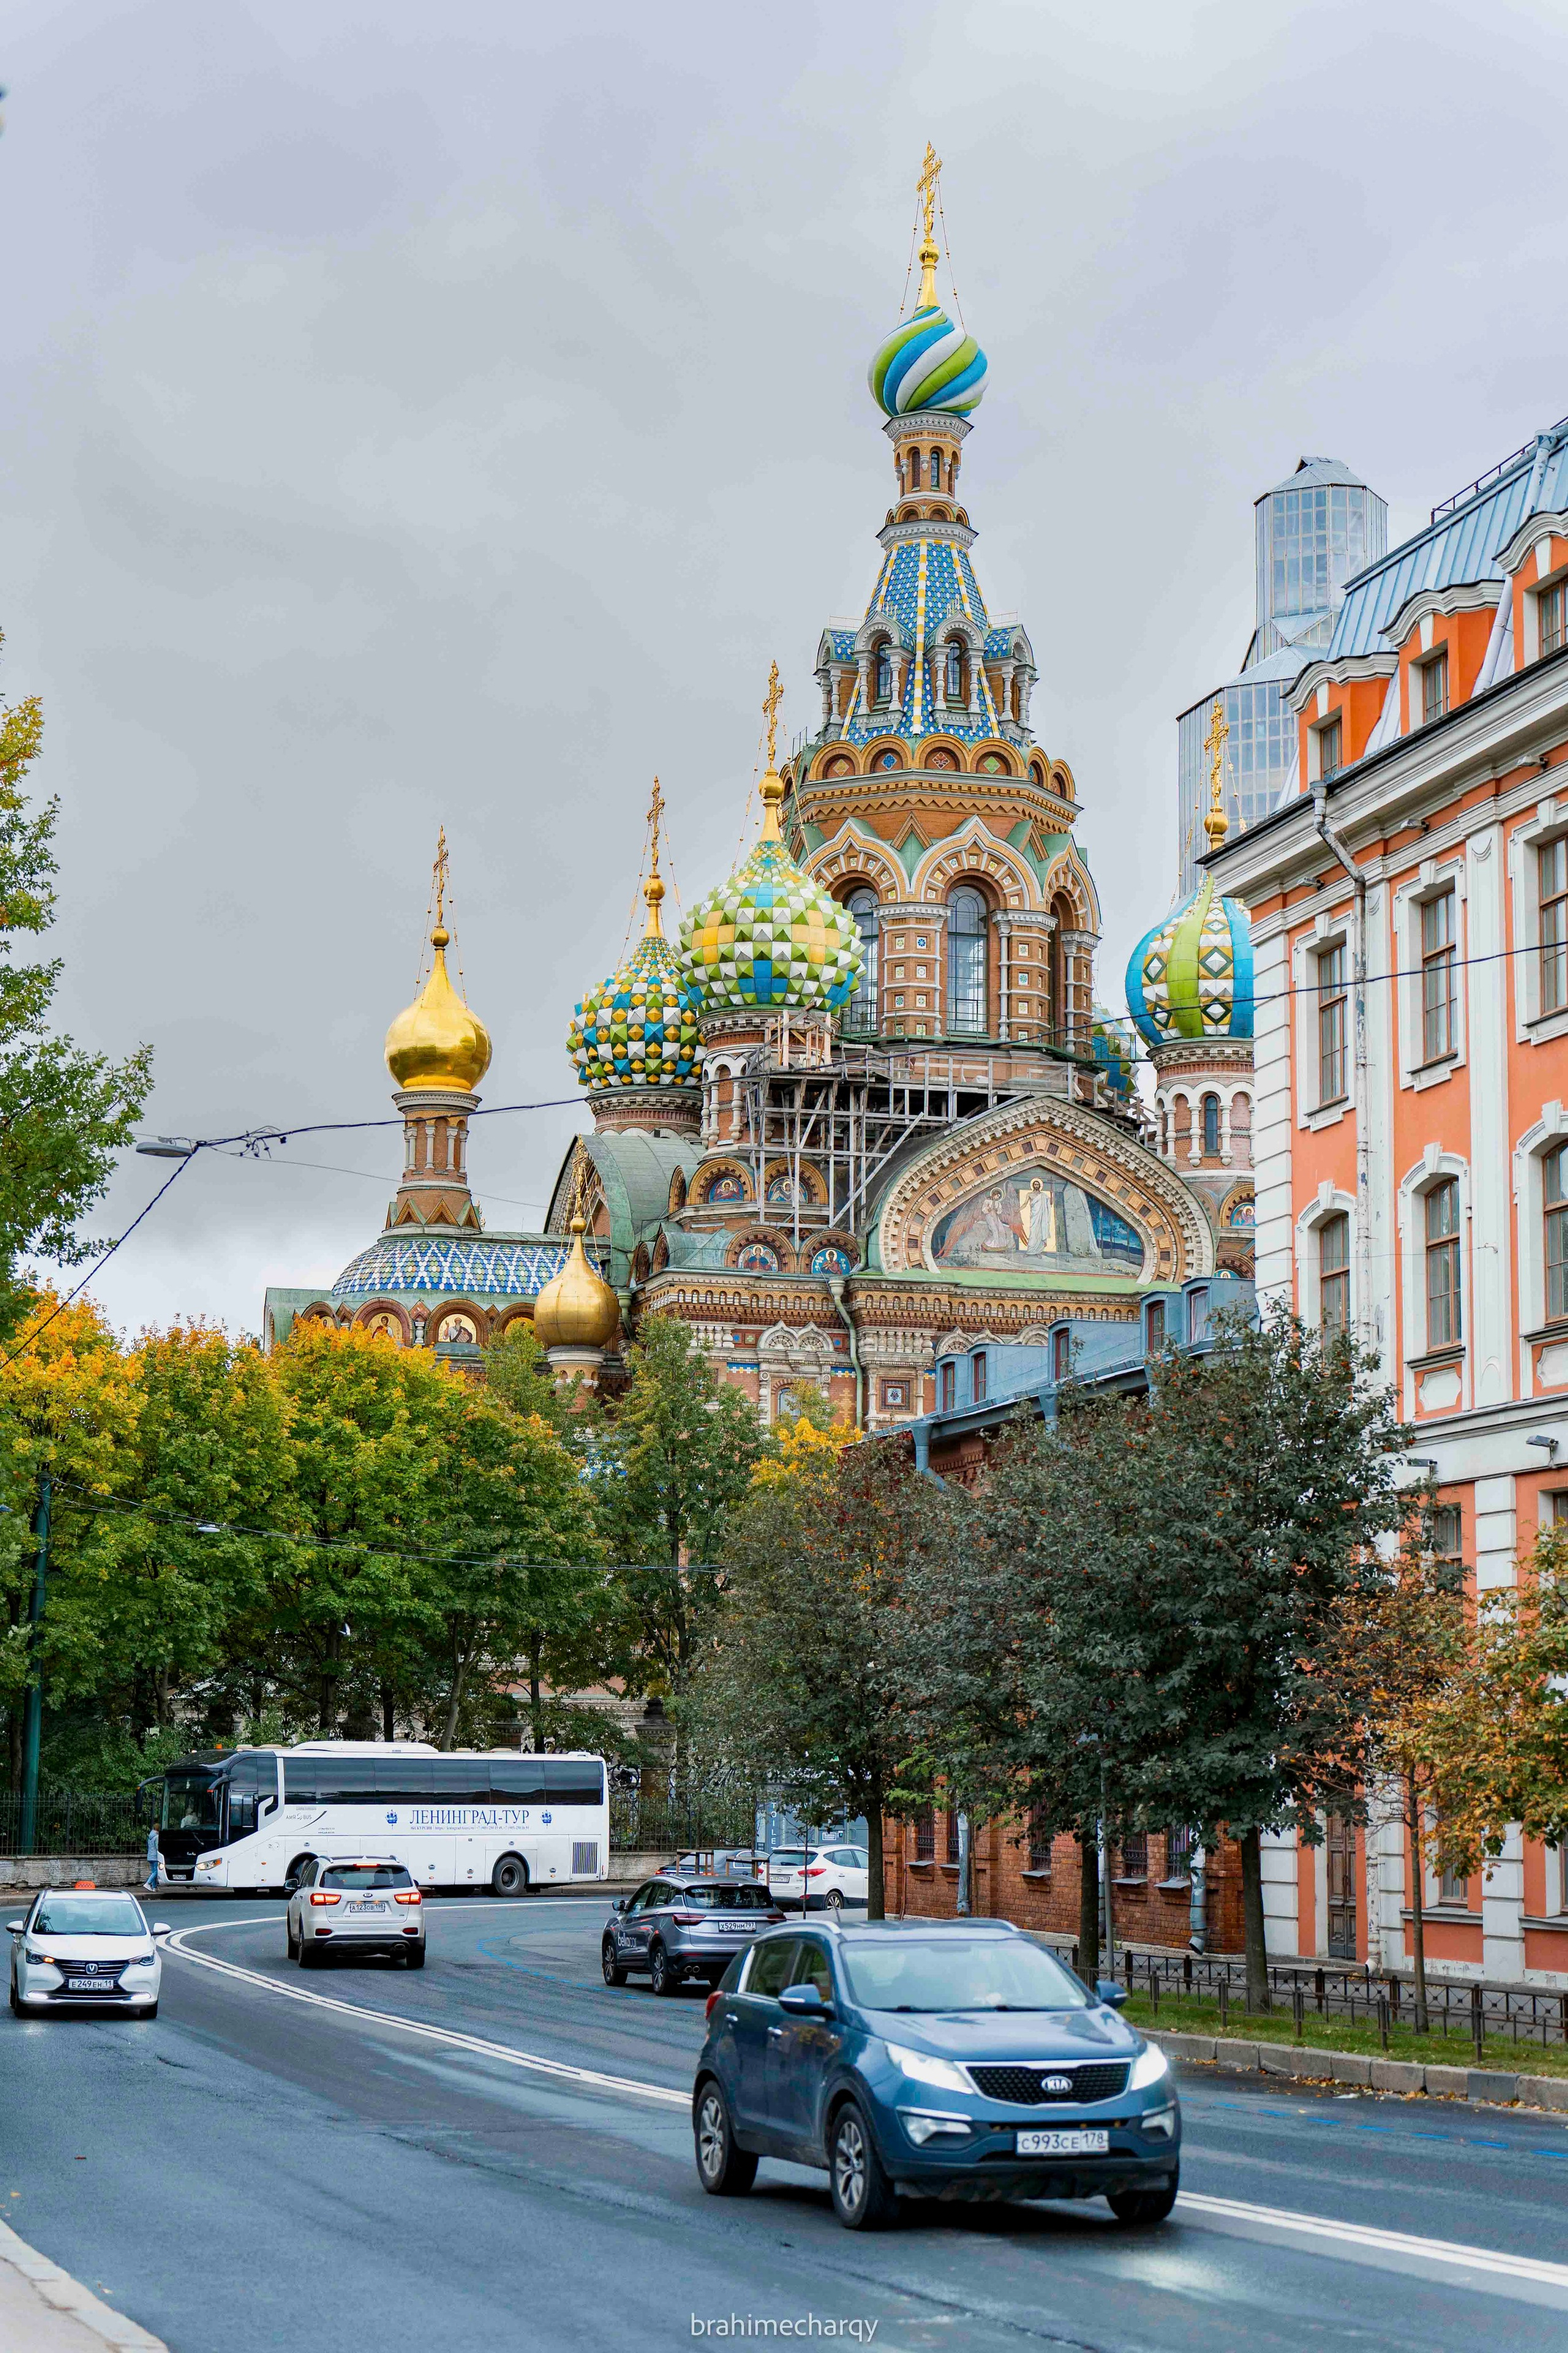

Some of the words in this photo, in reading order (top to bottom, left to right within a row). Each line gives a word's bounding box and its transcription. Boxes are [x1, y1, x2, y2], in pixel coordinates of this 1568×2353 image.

[410, 1810, 529, 1826] ЛЕНИНГРАД-ТУР
[1046, 2079, 1069, 2090] KIA
[1082, 2132, 1103, 2145] 178
